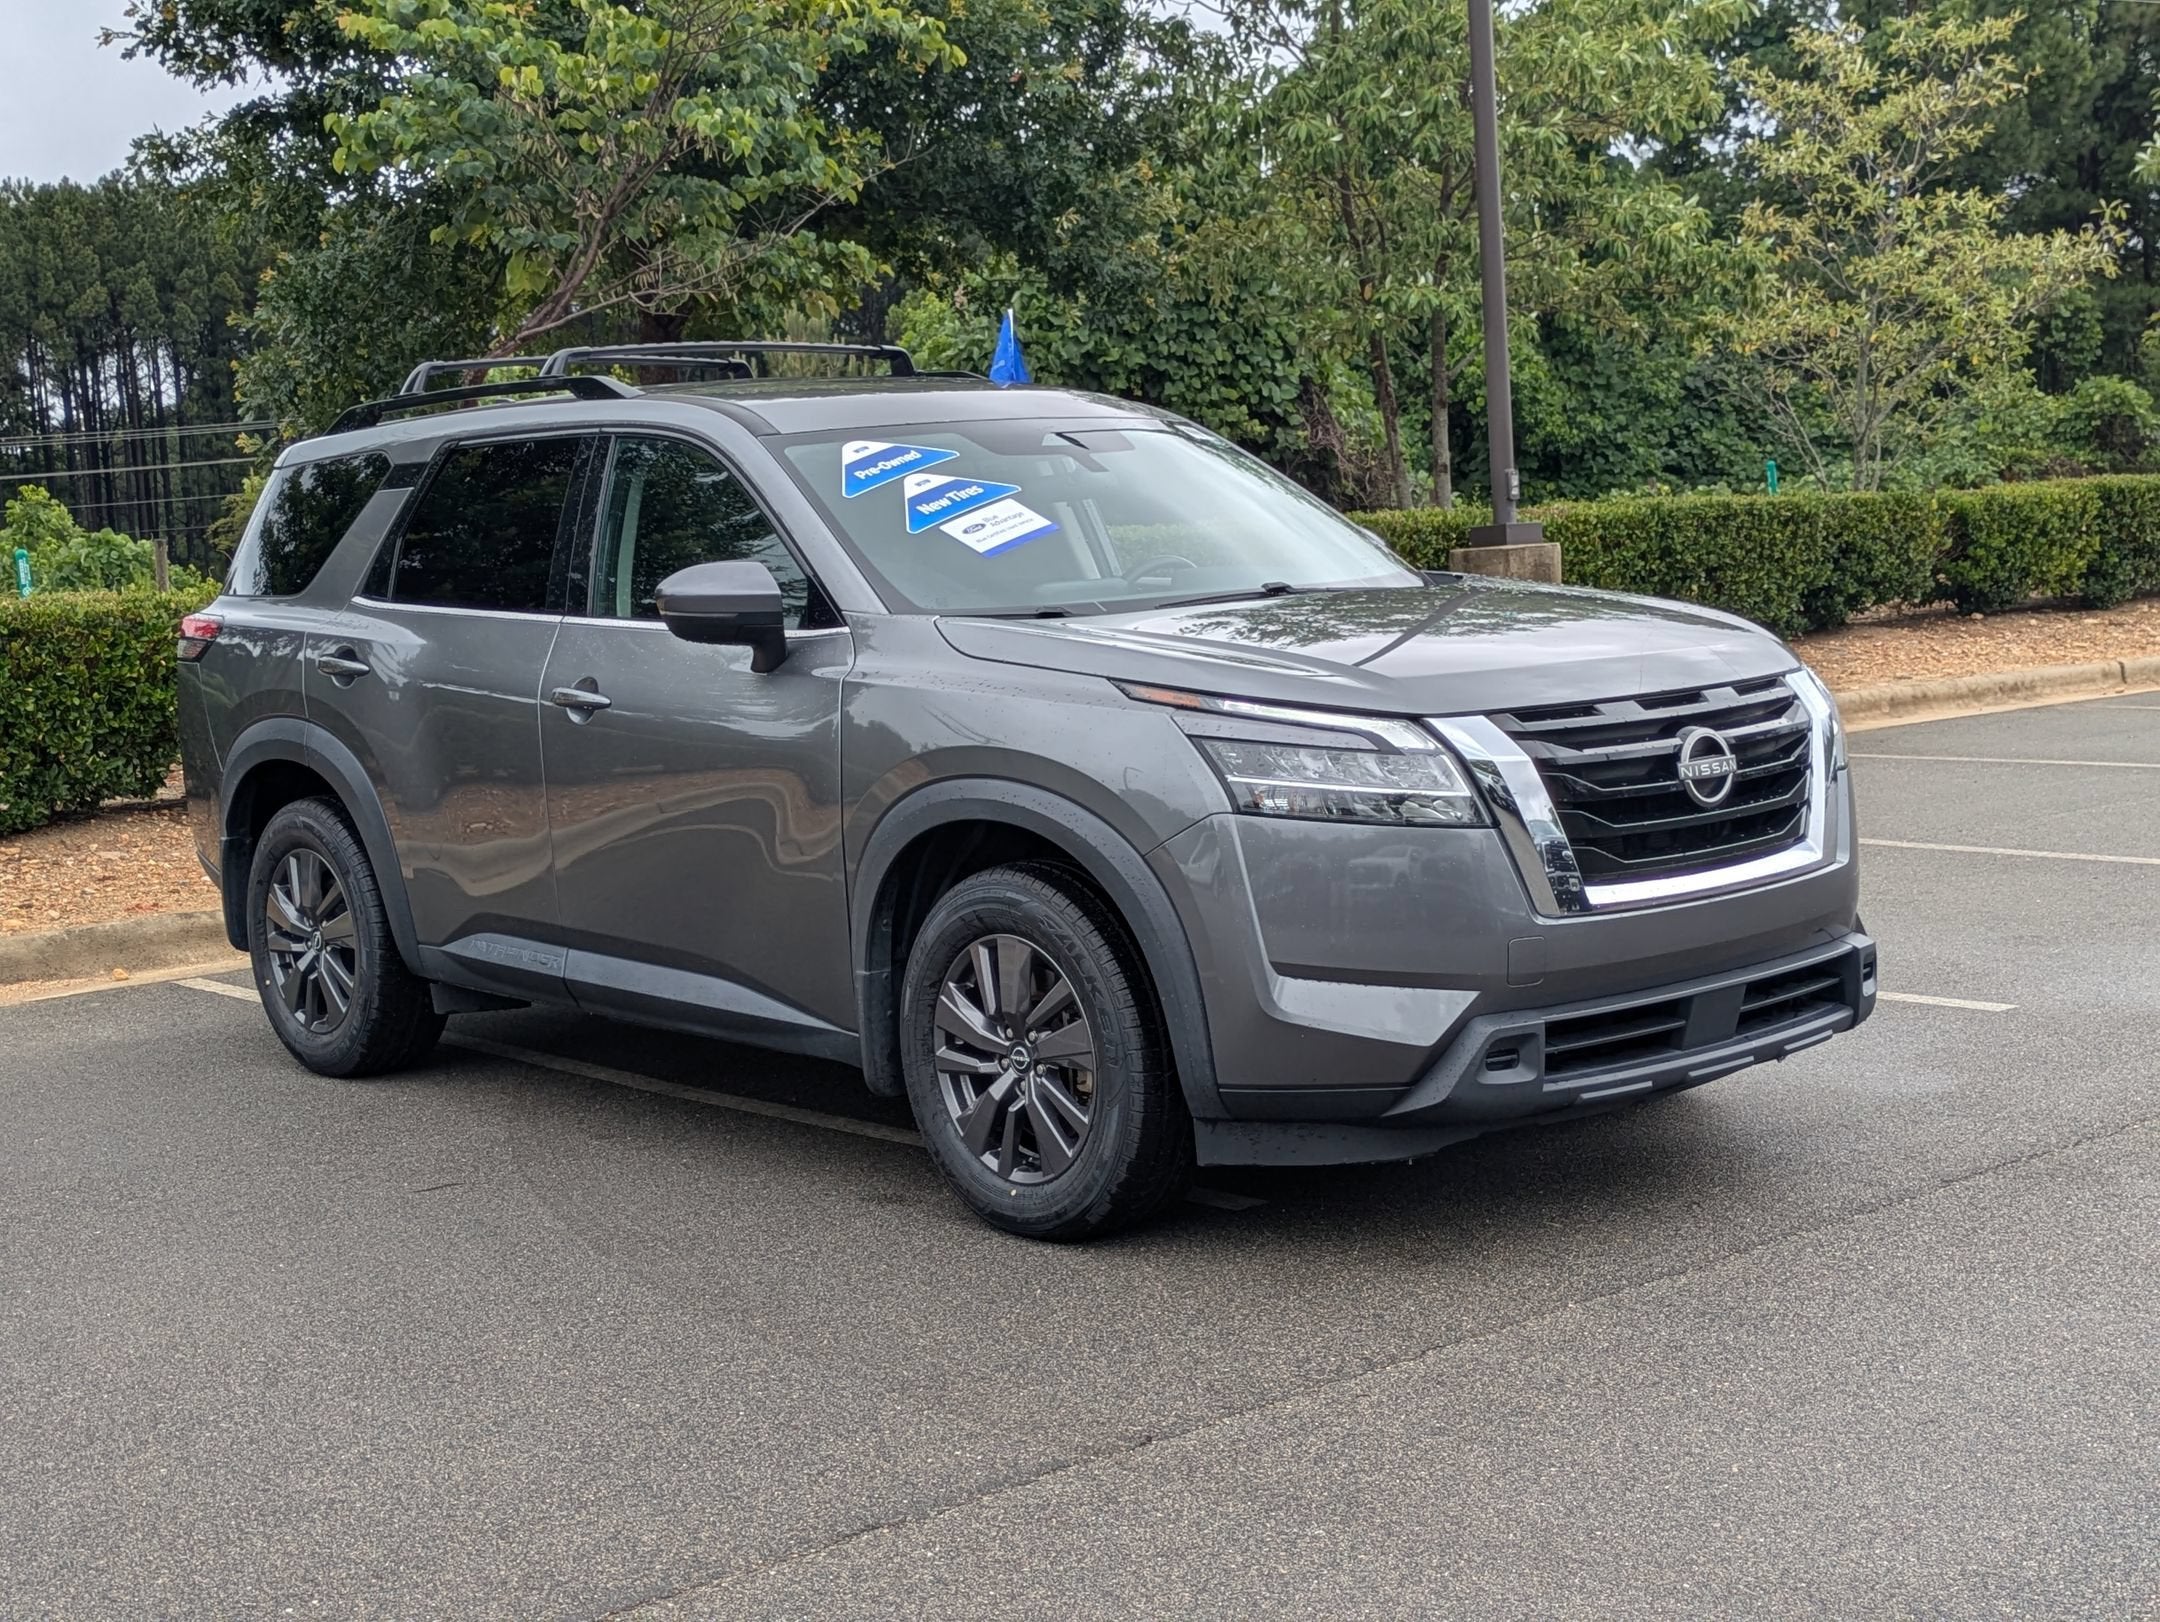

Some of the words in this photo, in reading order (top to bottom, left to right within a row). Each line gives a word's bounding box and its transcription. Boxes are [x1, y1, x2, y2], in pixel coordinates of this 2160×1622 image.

[853, 449, 923, 480] Pre-Owned
[916, 496, 953, 516] New
[945, 485, 985, 502] Tires
[1680, 759, 1737, 778] NISSAN
[468, 939, 562, 970] PATHFINDER
